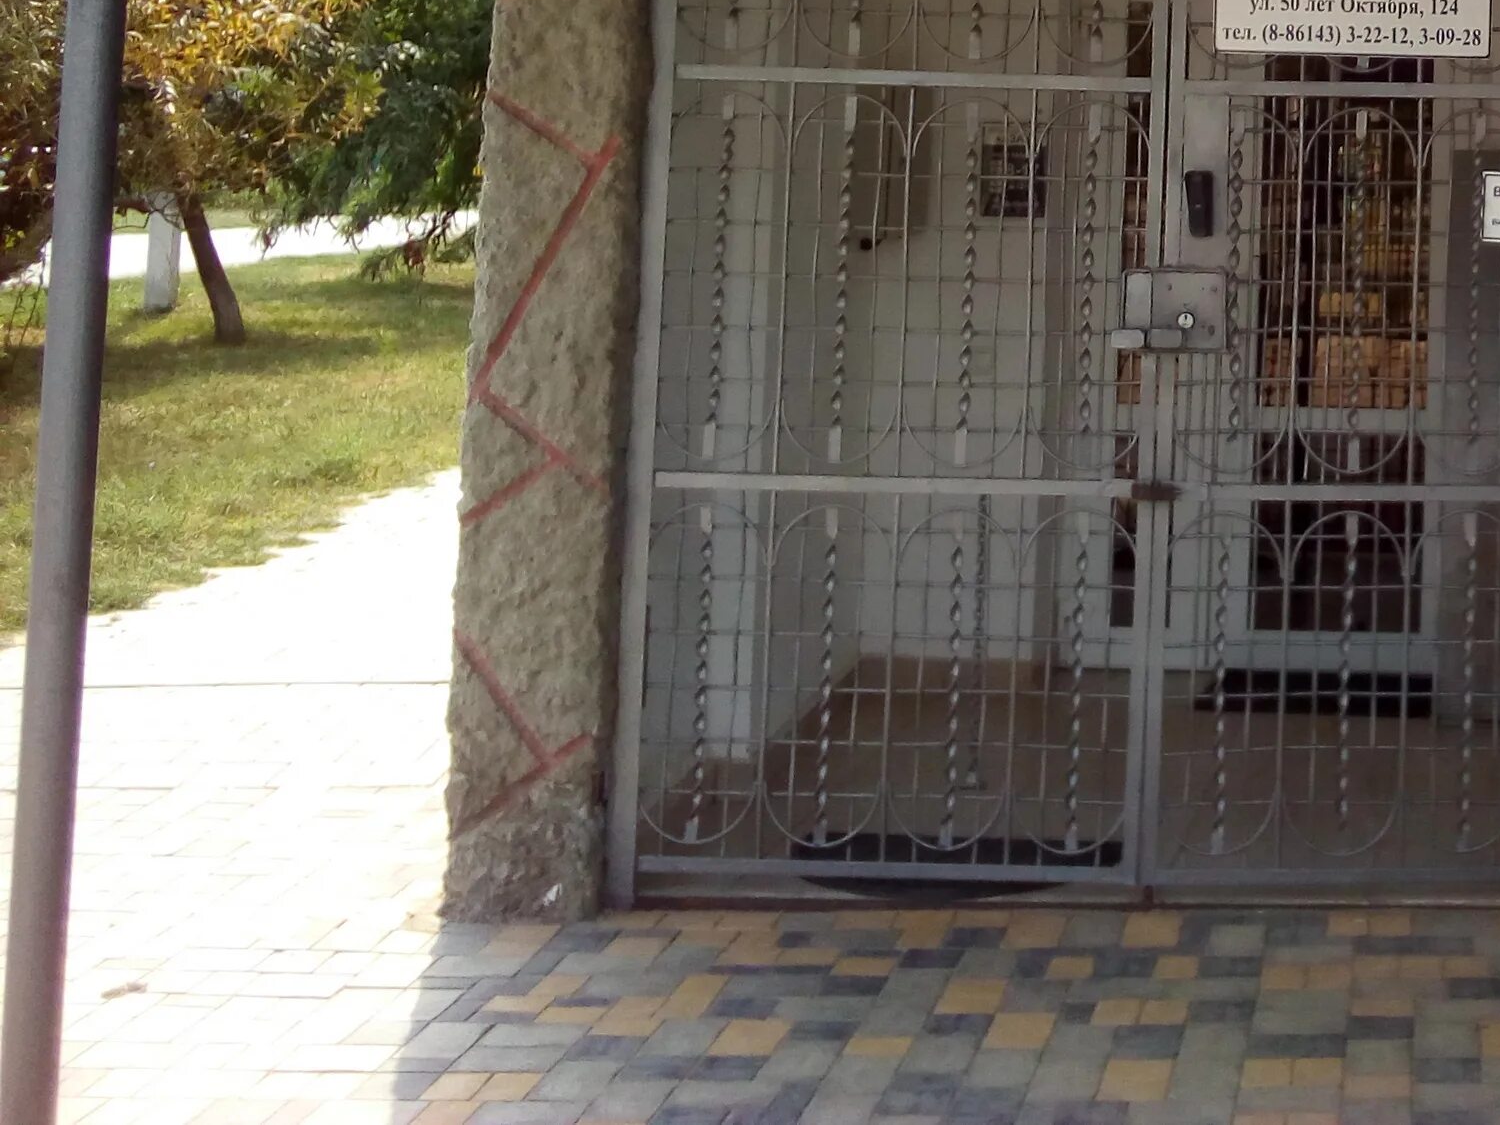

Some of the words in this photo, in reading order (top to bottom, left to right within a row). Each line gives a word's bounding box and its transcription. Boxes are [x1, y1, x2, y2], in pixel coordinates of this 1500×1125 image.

[1304, 0, 1336, 13] лет
[1222, 26, 1257, 43] тел.
[1261, 24, 1341, 47] (8-86143)
[1346, 26, 1415, 47] 3-22-12,
[1418, 27, 1482, 46] 3-09-28
